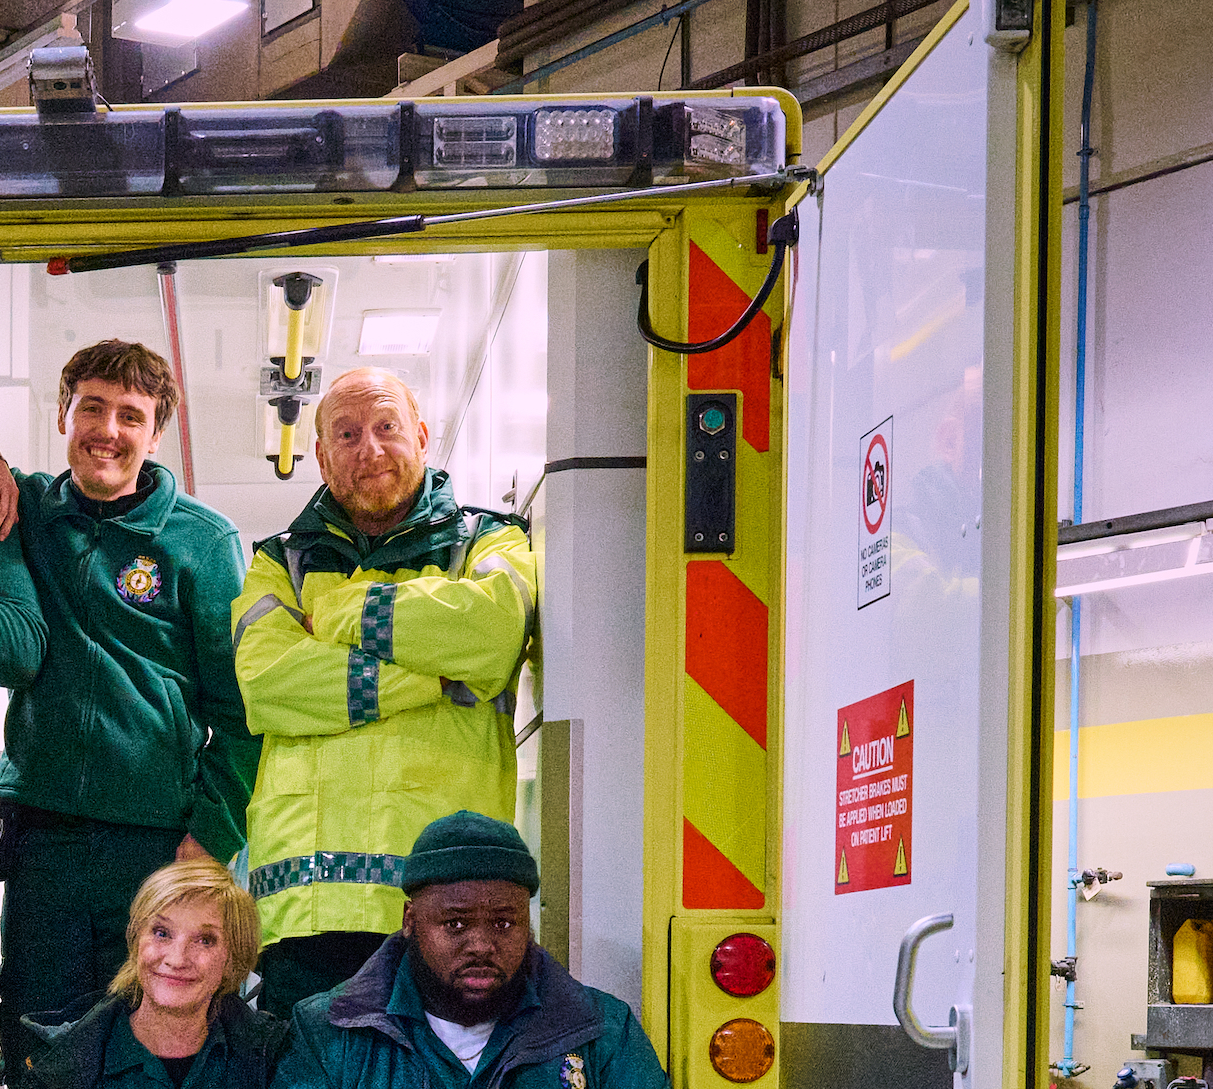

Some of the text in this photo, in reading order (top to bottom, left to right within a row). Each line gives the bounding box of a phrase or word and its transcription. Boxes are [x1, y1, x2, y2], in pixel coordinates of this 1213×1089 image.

[861, 536, 889, 561] NO CAMERAS
[861, 554, 887, 578] OR CAMERA
[865, 573, 883, 592] PHONES
[852, 735, 894, 774] CAUTION
[839, 774, 908, 806] STRETCHER BRAKES MUST
[838, 798, 907, 828] BE APPLIED WHEN LOADED
[851, 824, 893, 847] ON PATIENT LIFT
